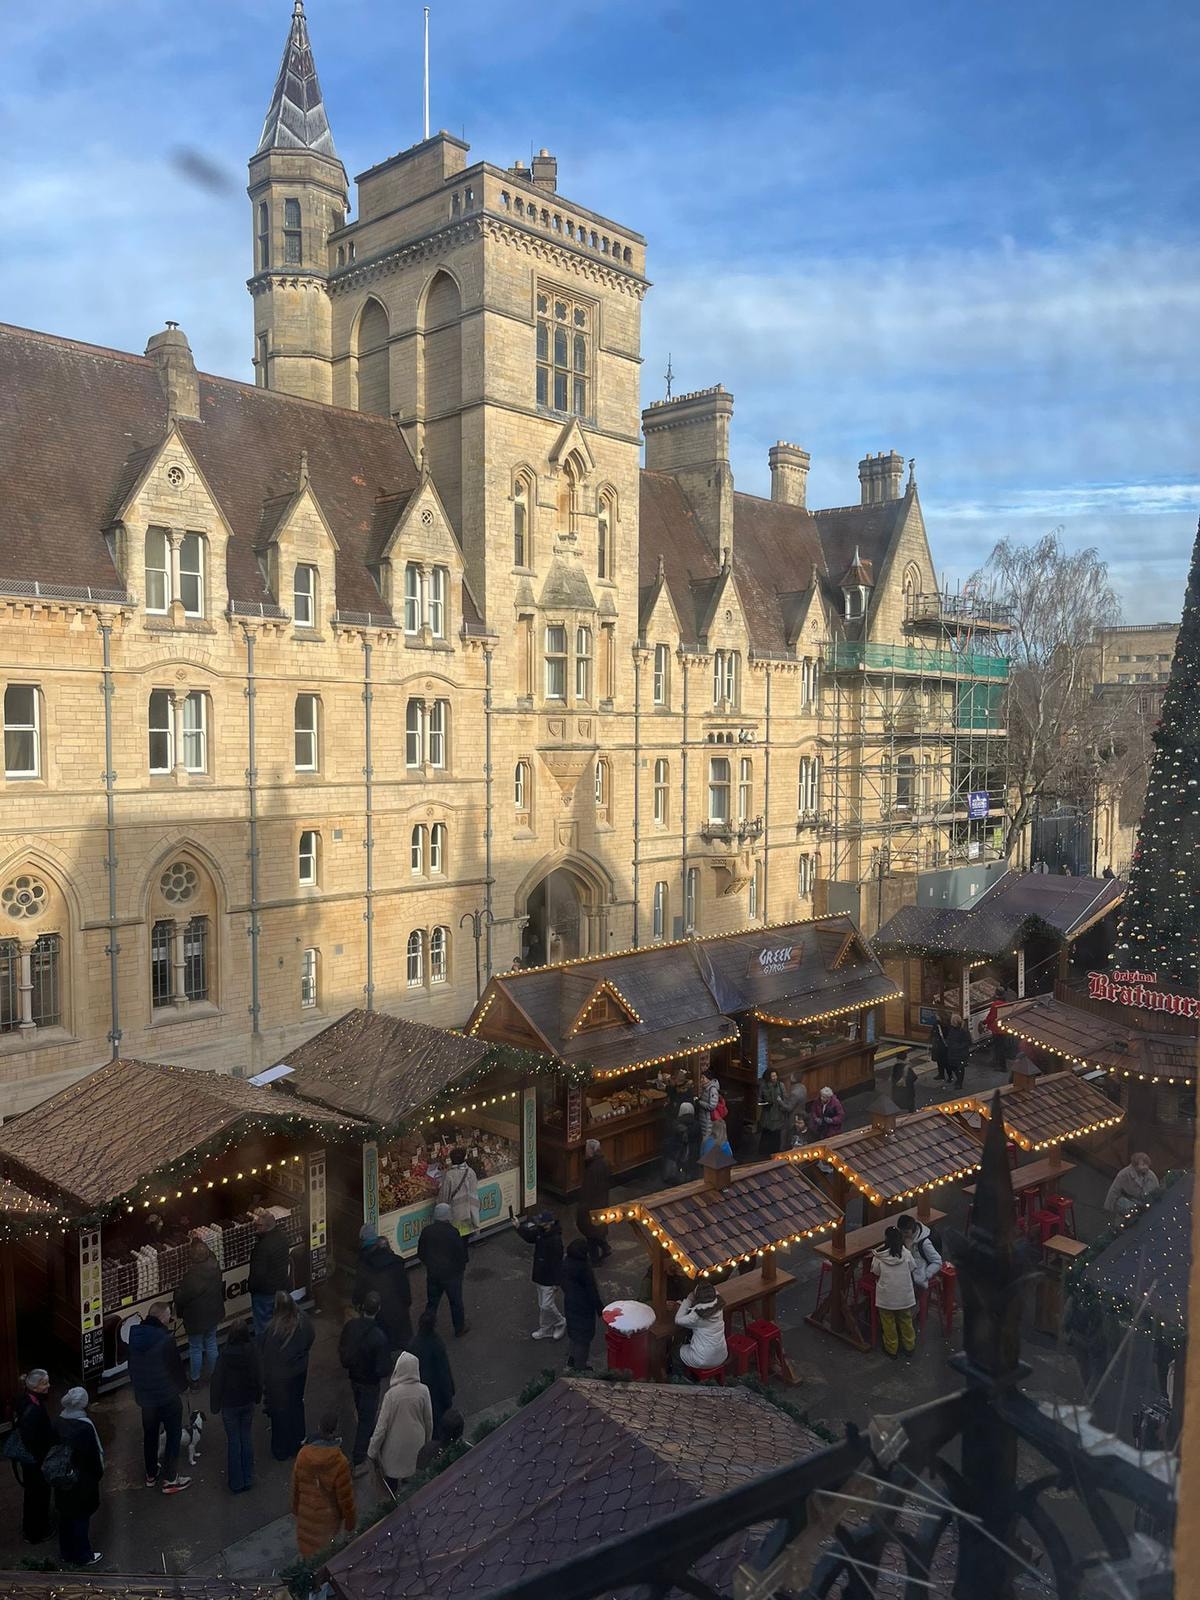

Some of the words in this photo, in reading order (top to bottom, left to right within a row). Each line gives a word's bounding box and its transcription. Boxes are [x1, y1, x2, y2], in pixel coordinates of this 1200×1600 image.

[759, 946, 792, 965] GREEK
[763, 962, 785, 975] GYROS
[1112, 969, 1157, 984] Original
